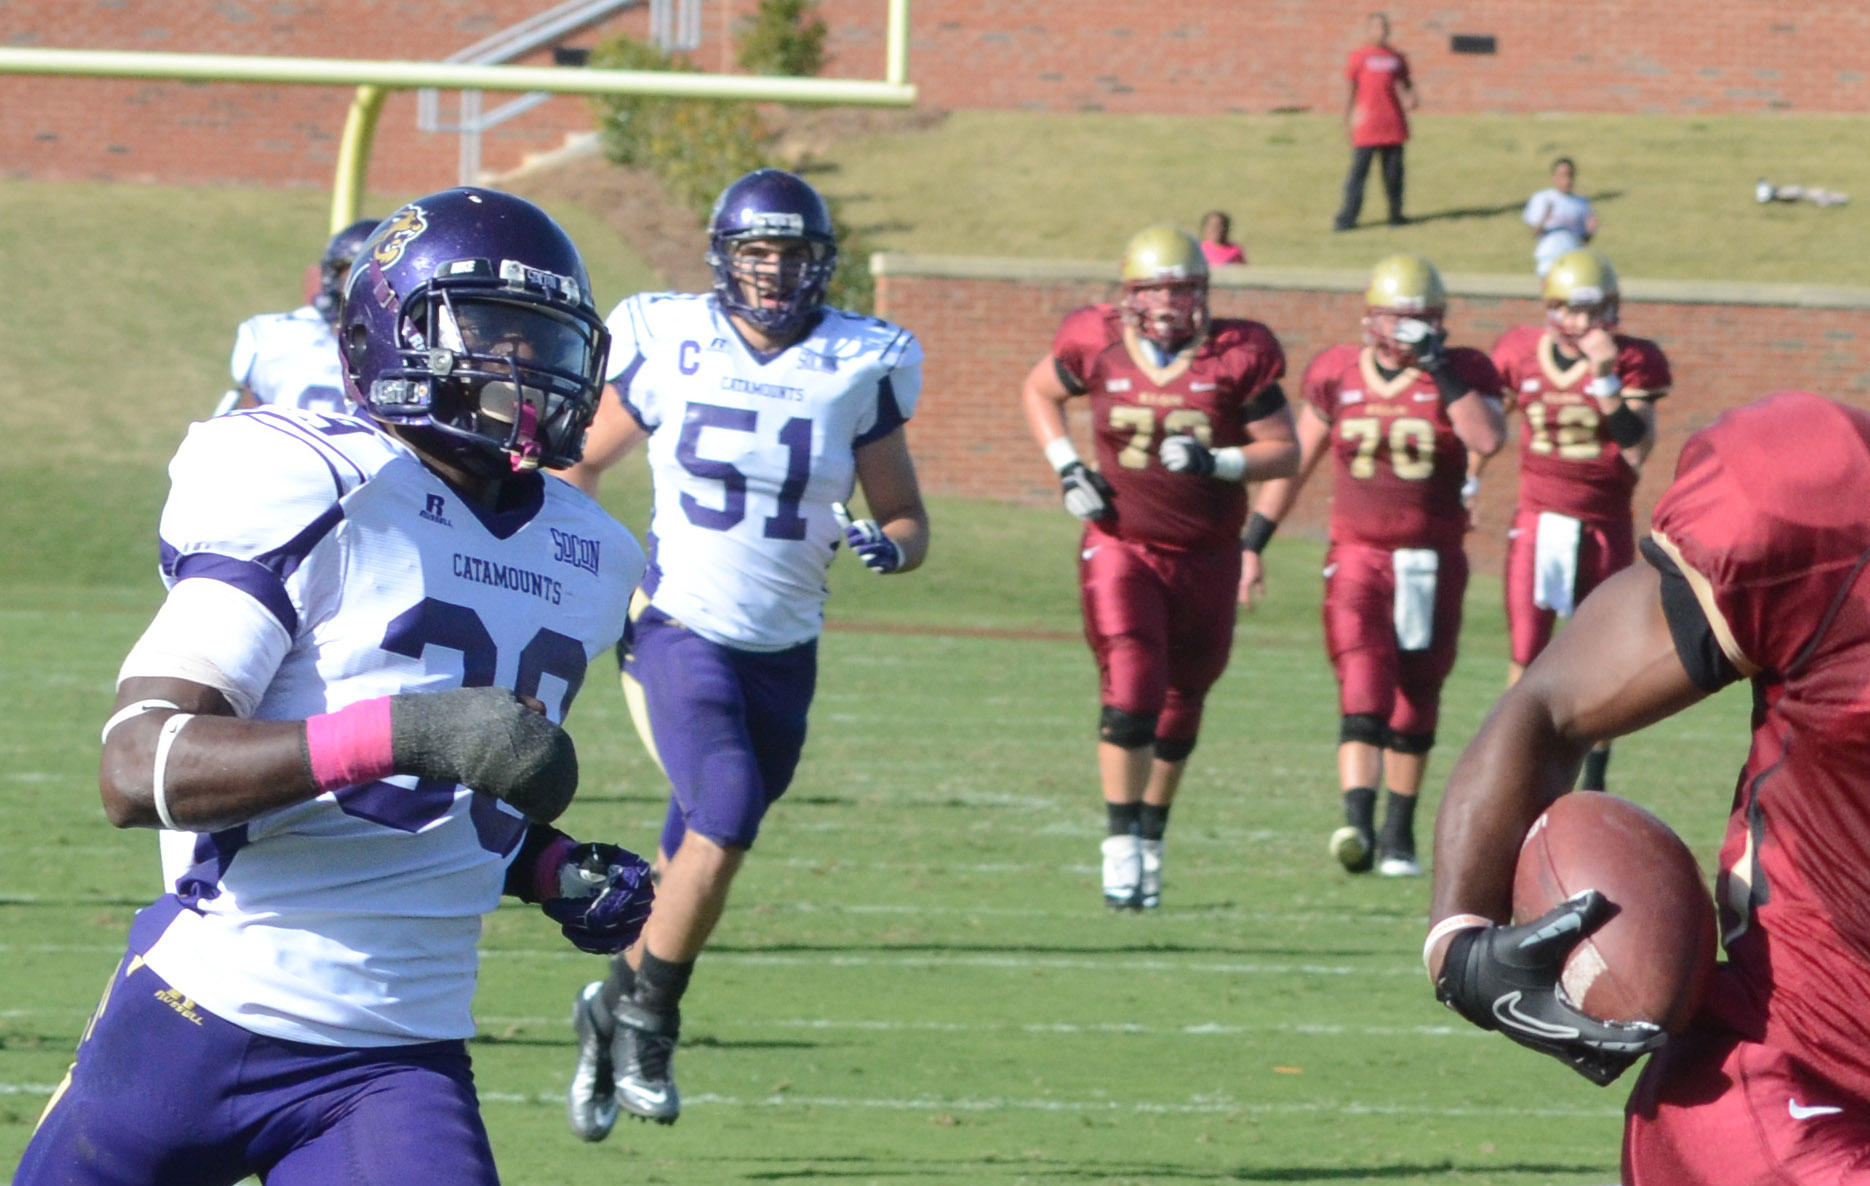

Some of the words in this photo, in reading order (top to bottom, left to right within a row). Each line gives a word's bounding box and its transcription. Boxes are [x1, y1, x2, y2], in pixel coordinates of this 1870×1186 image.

[678, 340, 701, 376] C
[1340, 417, 1436, 480] 70
[1526, 401, 1602, 460] 12
[675, 401, 813, 541] 51
[426, 492, 446, 518] R
[452, 552, 562, 606] CATAMOUNTS
[550, 527, 601, 577] SOCON
